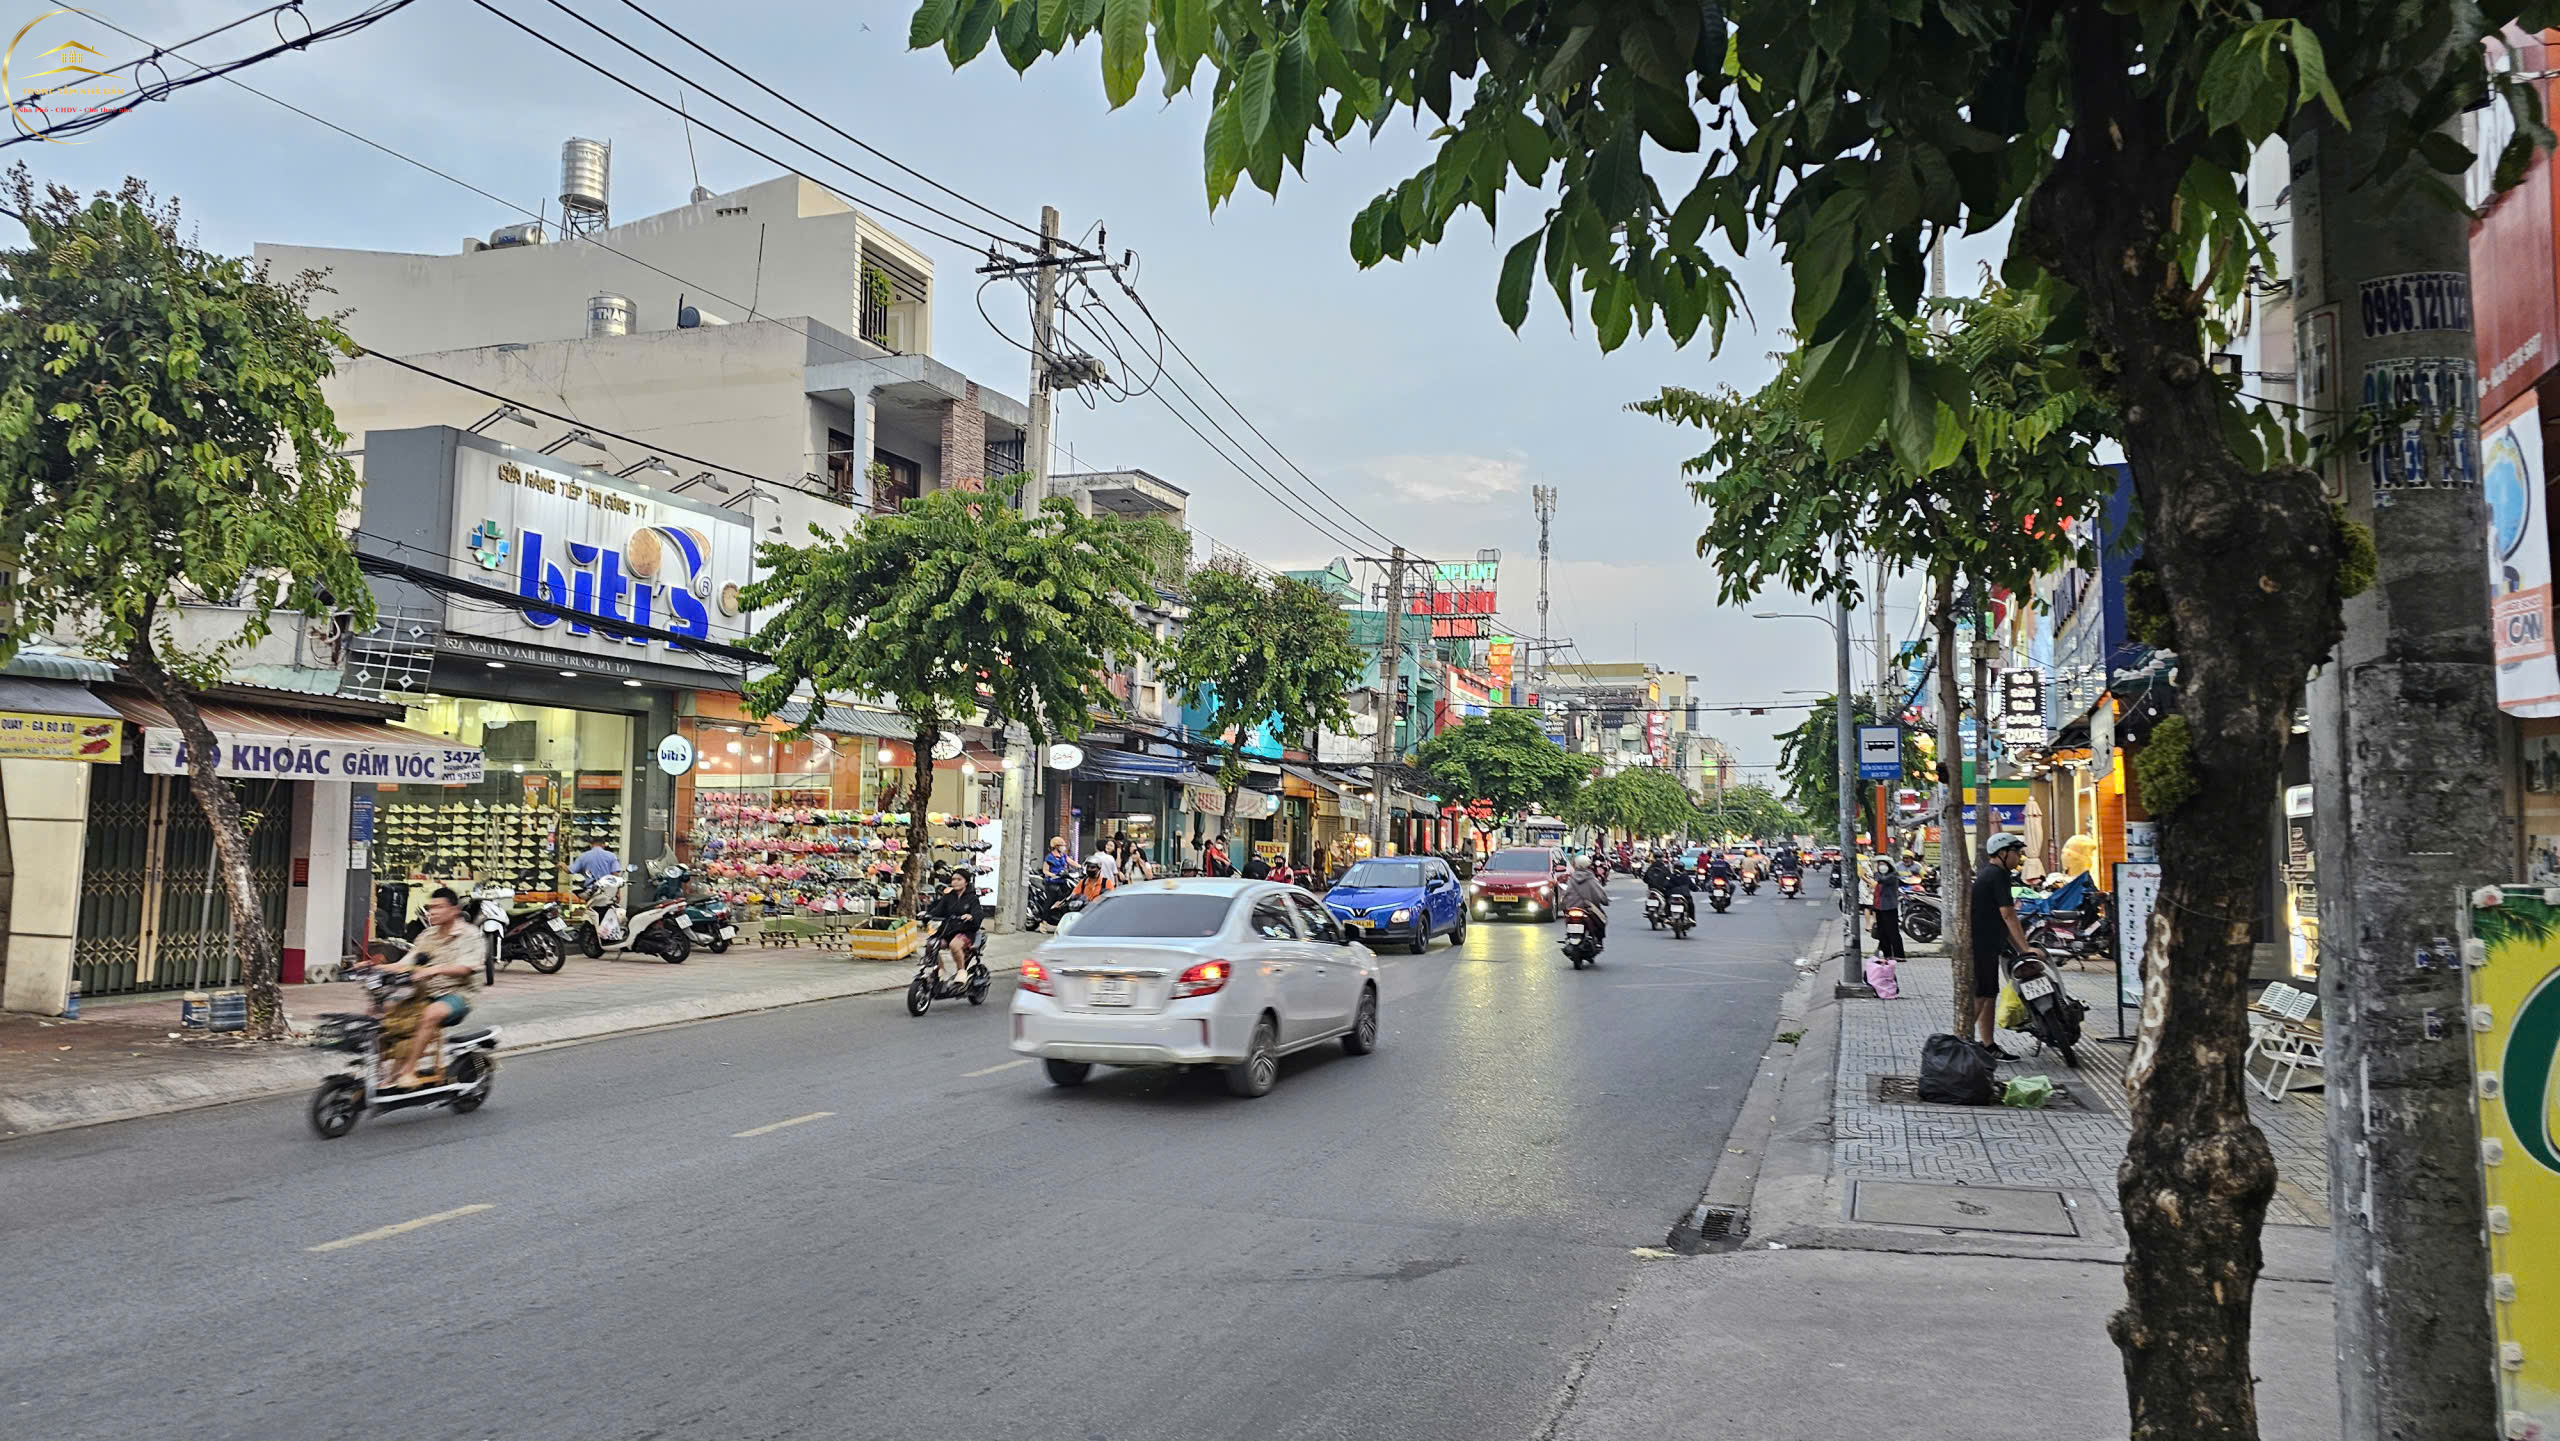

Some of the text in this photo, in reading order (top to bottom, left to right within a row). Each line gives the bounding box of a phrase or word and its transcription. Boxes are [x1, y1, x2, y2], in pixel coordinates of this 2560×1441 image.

[525, 470, 556, 495] HÀNG
[560, 478, 582, 500] TIẾP
[604, 492, 631, 515] CÔNG
[635, 503, 648, 518] TY
[232, 744, 330, 774] KHOÁC
[343, 747, 388, 776] GẤM
[395, 752, 435, 778] VÓC
